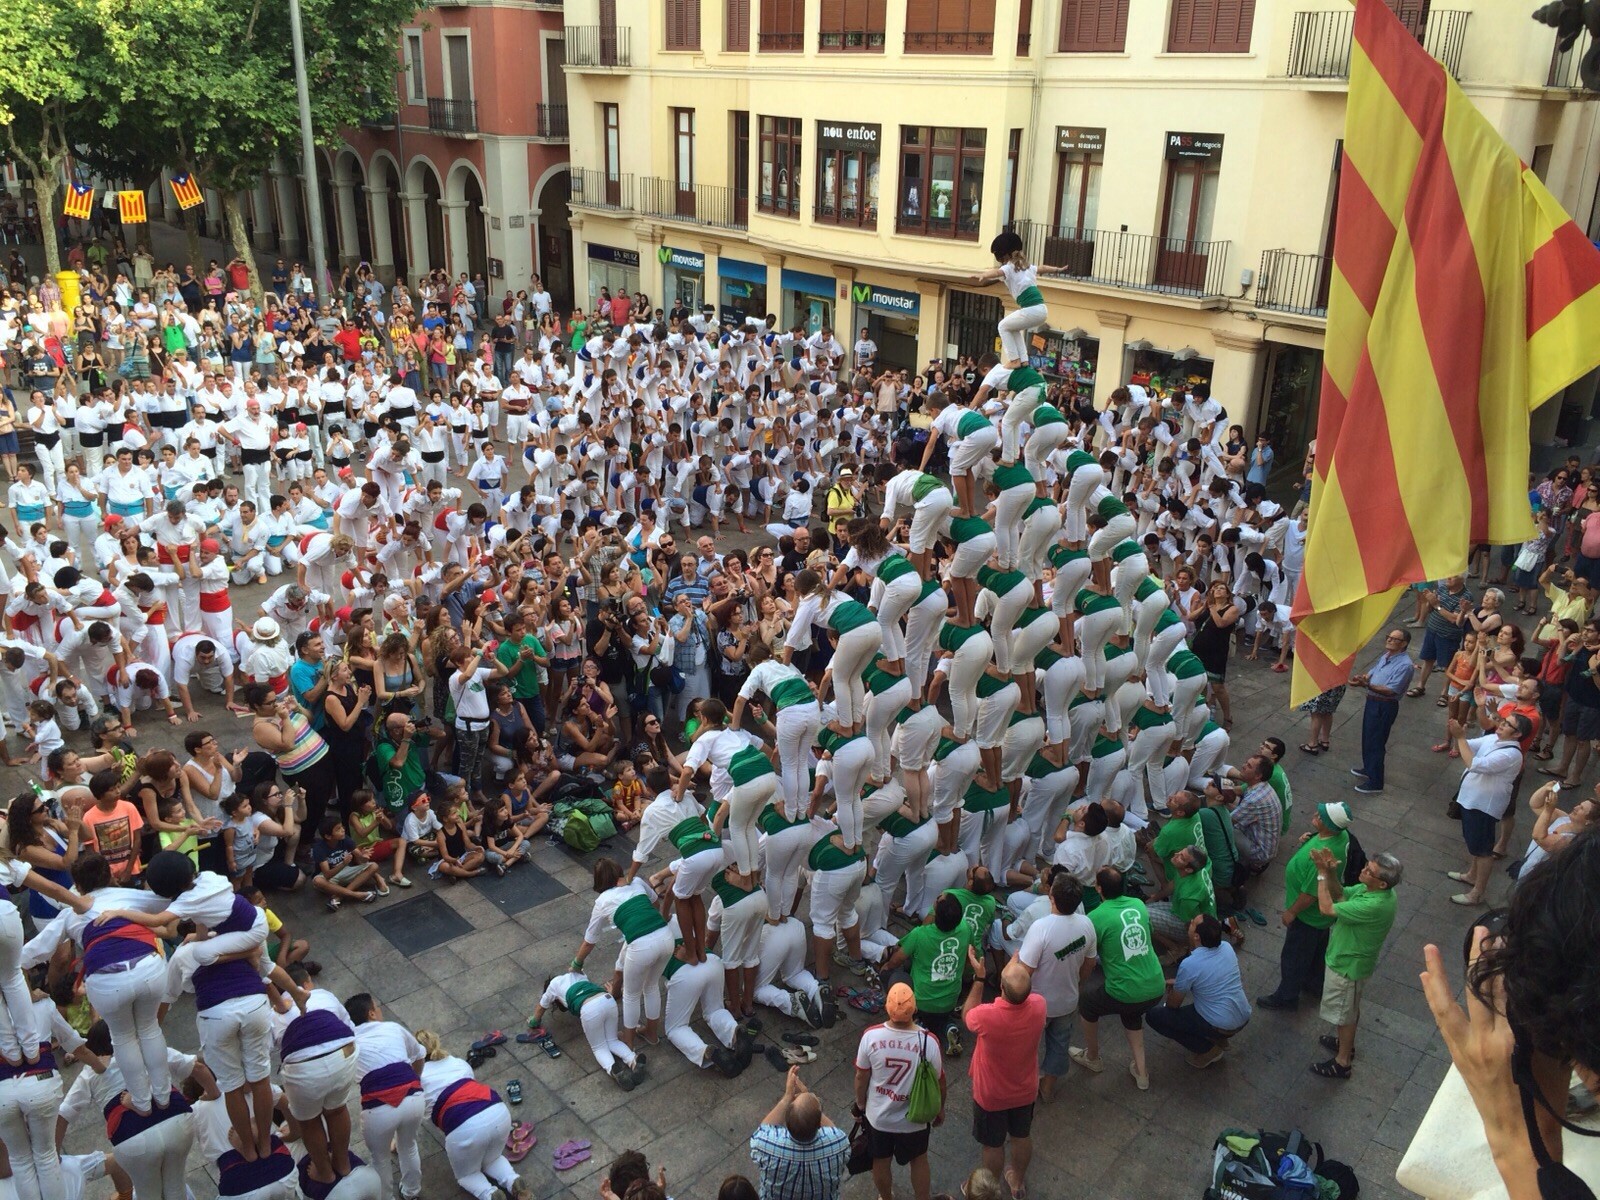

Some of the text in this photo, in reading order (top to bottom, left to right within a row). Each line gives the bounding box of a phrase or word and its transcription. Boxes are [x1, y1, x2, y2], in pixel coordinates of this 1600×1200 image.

[823, 126, 877, 141] nou enfoc
[1170, 135, 1192, 147] PASS
[1201, 142, 1221, 150] negocis
[671, 254, 704, 268] movistar
[872, 293, 915, 310] movistar
[871, 1040, 919, 1054] ENGLAN
[885, 1057, 911, 1086] 7
